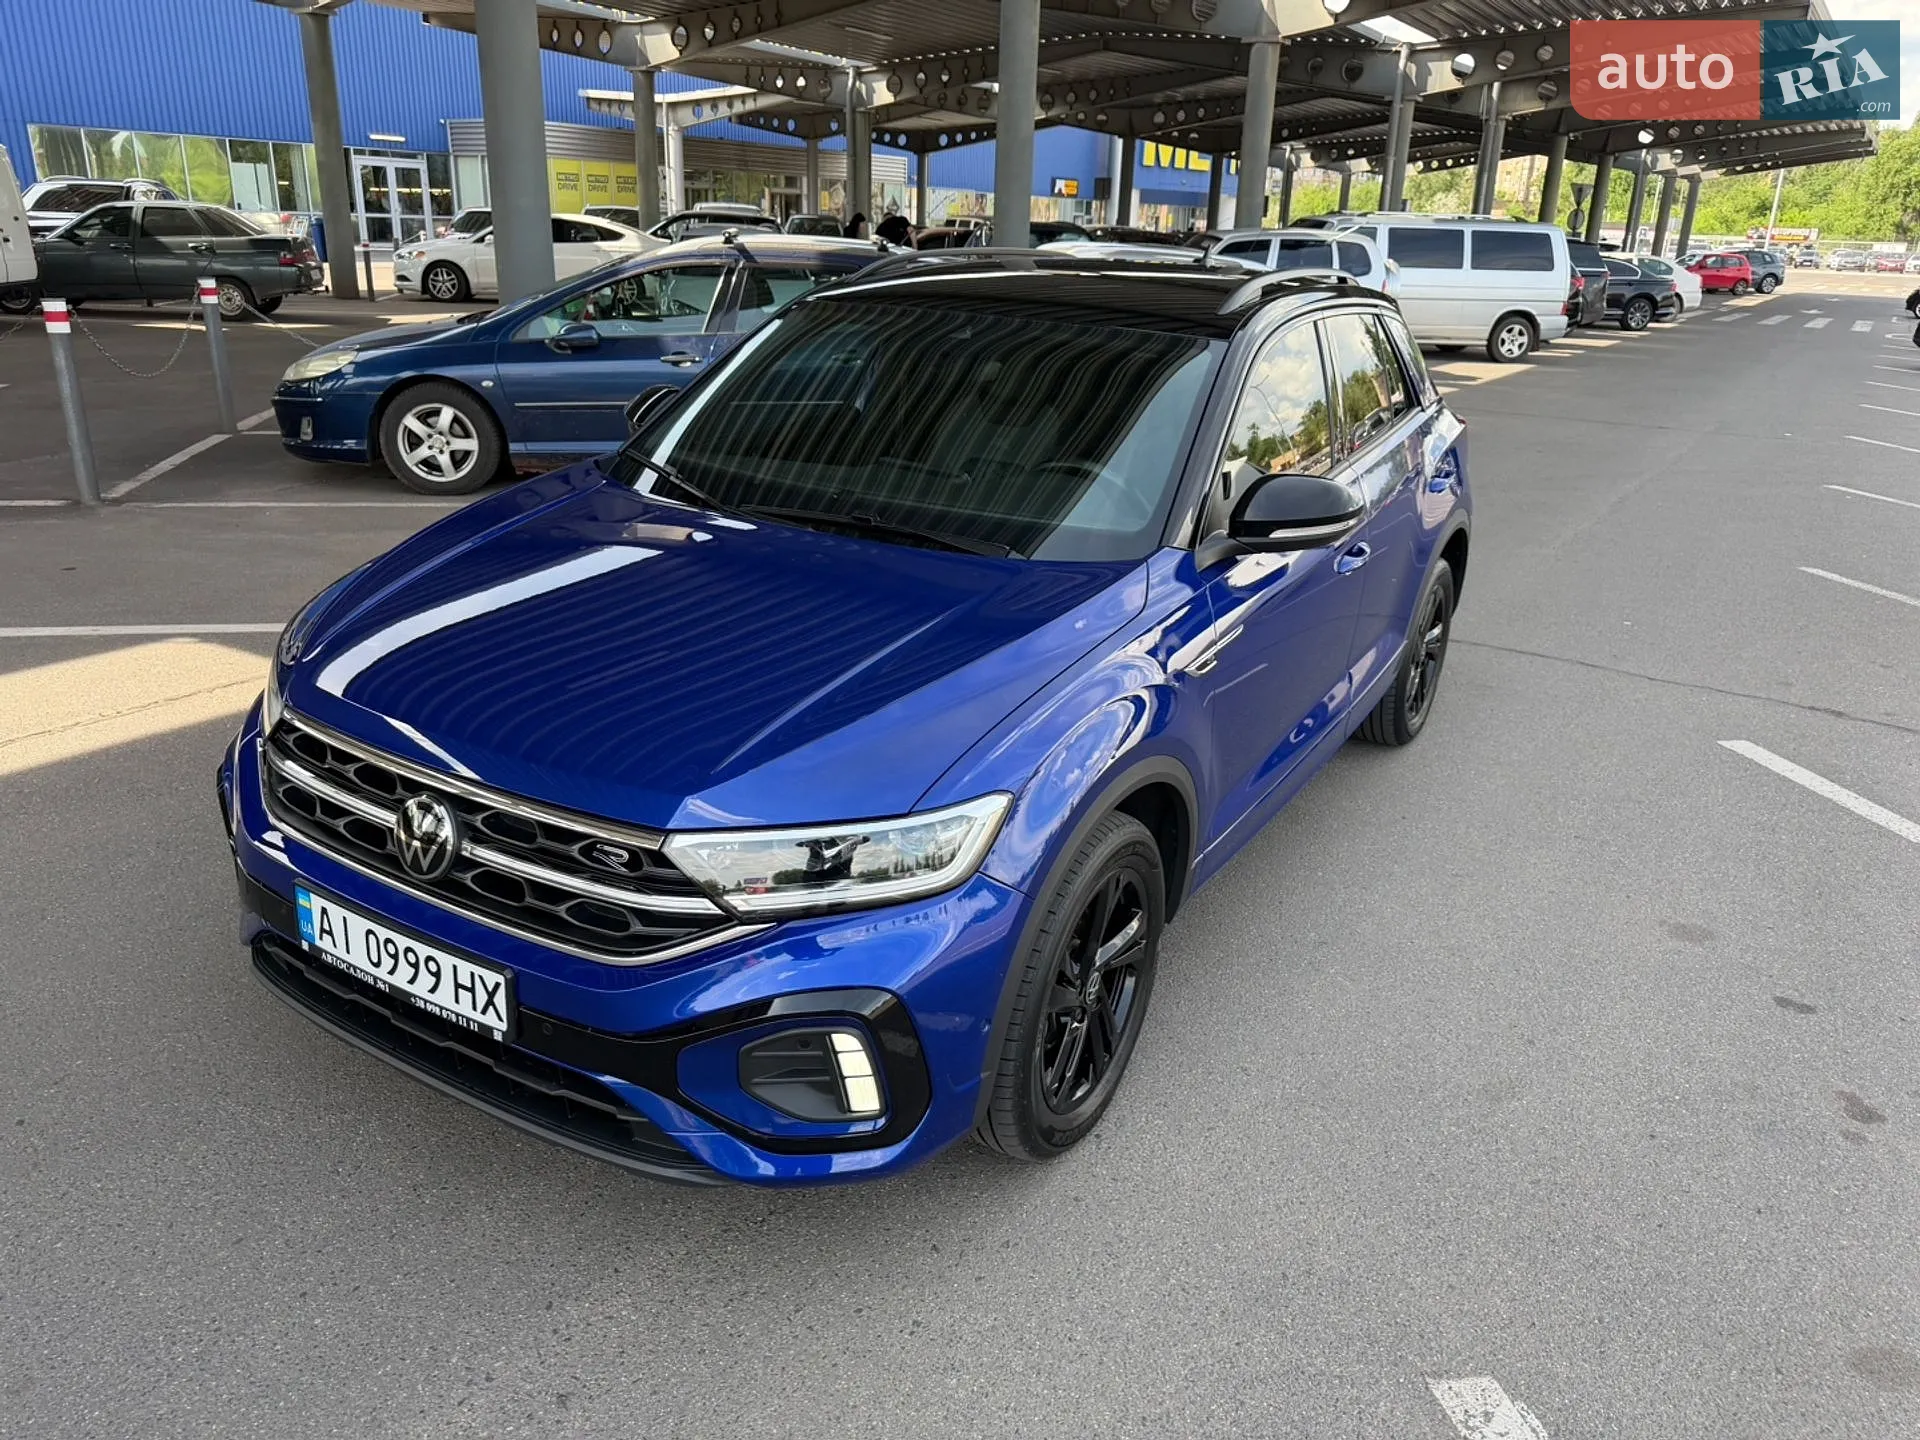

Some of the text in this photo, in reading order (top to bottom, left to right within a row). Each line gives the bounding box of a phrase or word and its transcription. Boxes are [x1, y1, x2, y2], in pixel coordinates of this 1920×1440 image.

[557, 183, 579, 192] DRIVE
[588, 184, 608, 193] DRIVE
[617, 186, 637, 194] DRIVE
[301, 920, 314, 935] UA
[318, 905, 505, 1023] AI 0999 HX
